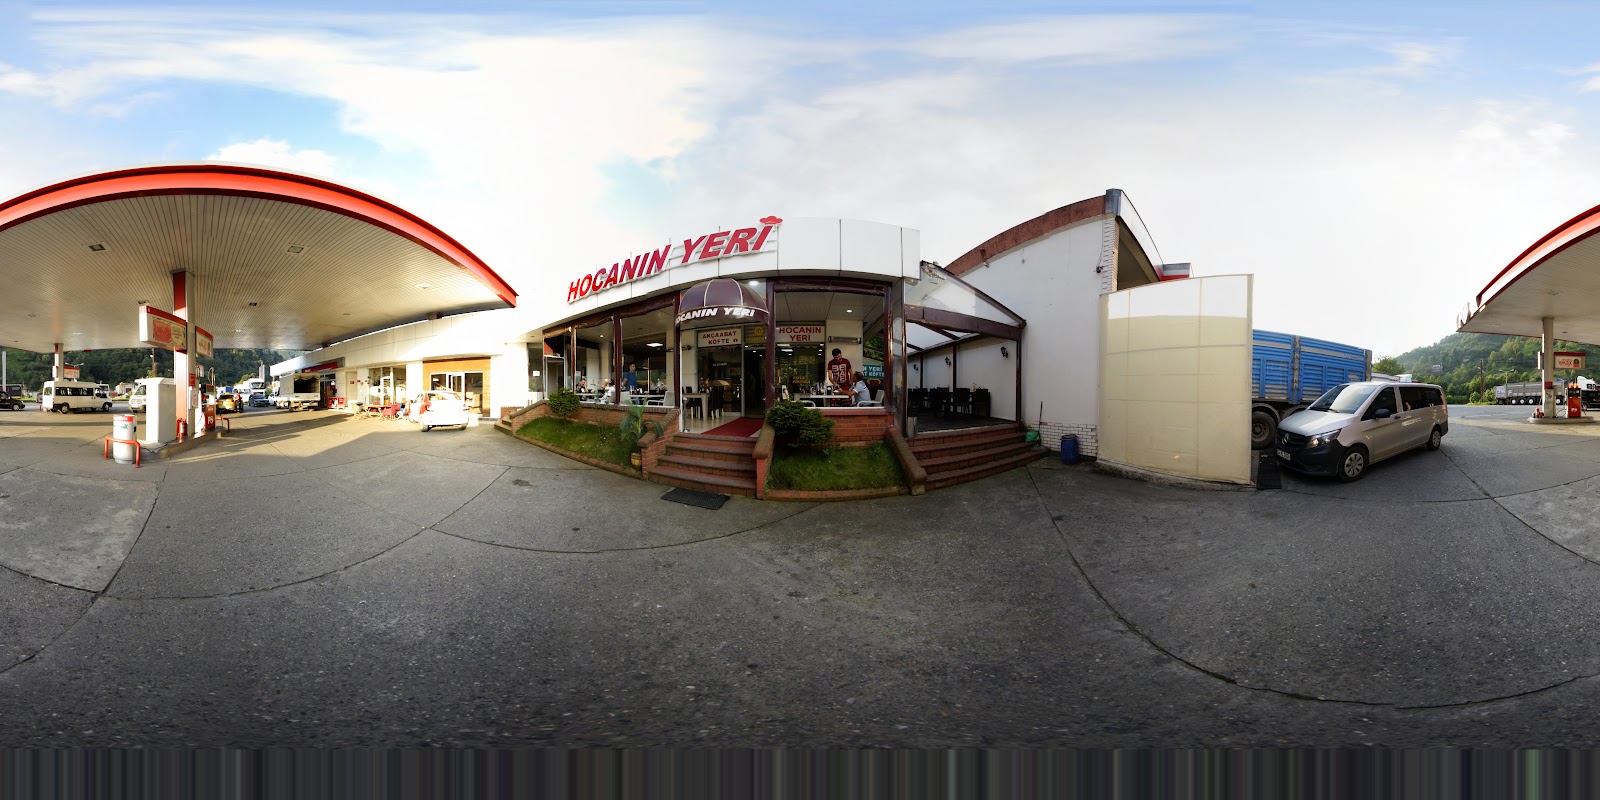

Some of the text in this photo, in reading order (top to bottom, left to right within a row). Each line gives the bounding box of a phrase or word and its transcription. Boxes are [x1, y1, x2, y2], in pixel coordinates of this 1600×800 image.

[567, 244, 672, 302] HOCANIN
[779, 326, 821, 334] HOCANIN
[790, 333, 810, 341] YERİ
